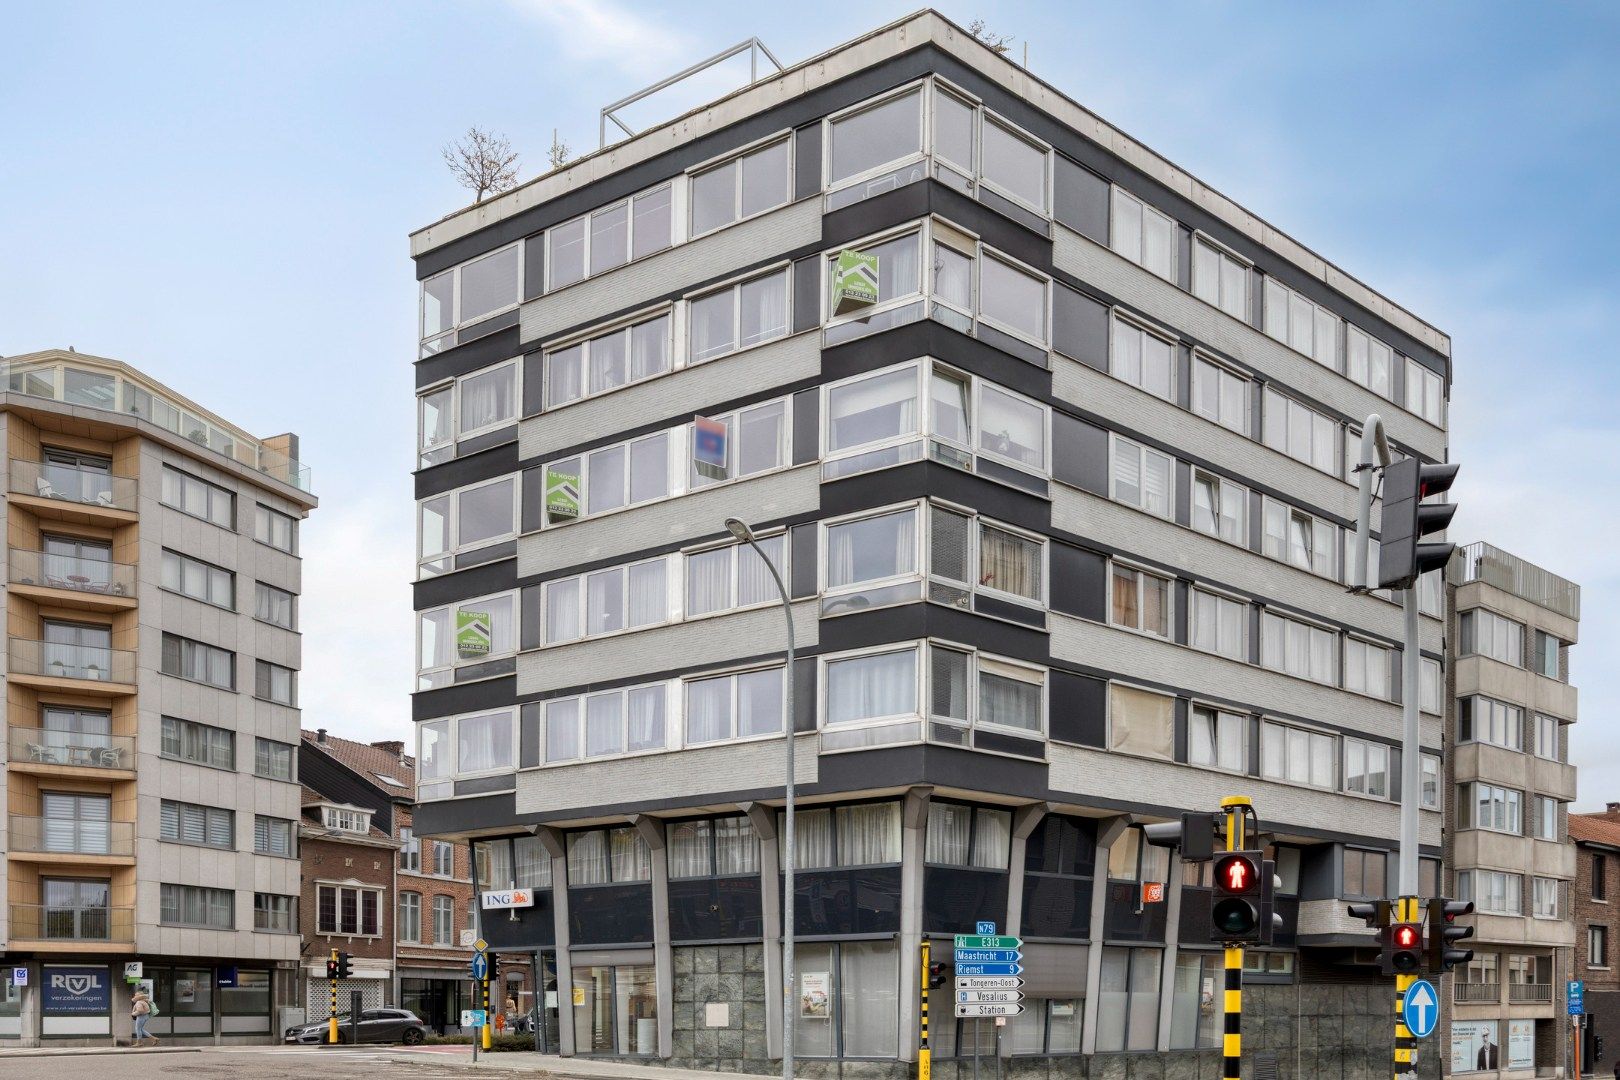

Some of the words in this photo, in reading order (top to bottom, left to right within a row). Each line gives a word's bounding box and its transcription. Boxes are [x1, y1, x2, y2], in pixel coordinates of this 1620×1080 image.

[855, 253, 876, 262] KOOP
[558, 473, 577, 481] KOOP
[486, 894, 510, 905] ING
[979, 924, 993, 933] N79
[981, 937, 1000, 947] E313
[957, 950, 997, 960] Maastricht
[1006, 951, 1014, 960] 17
[958, 965, 984, 974] Riemst
[1009, 965, 1015, 974] 9
[970, 979, 1015, 988] Tongeren-Oost
[1570, 982, 1580, 992] P
[977, 991, 1008, 1001] Vesalius
[979, 1005, 1006, 1014] Station
